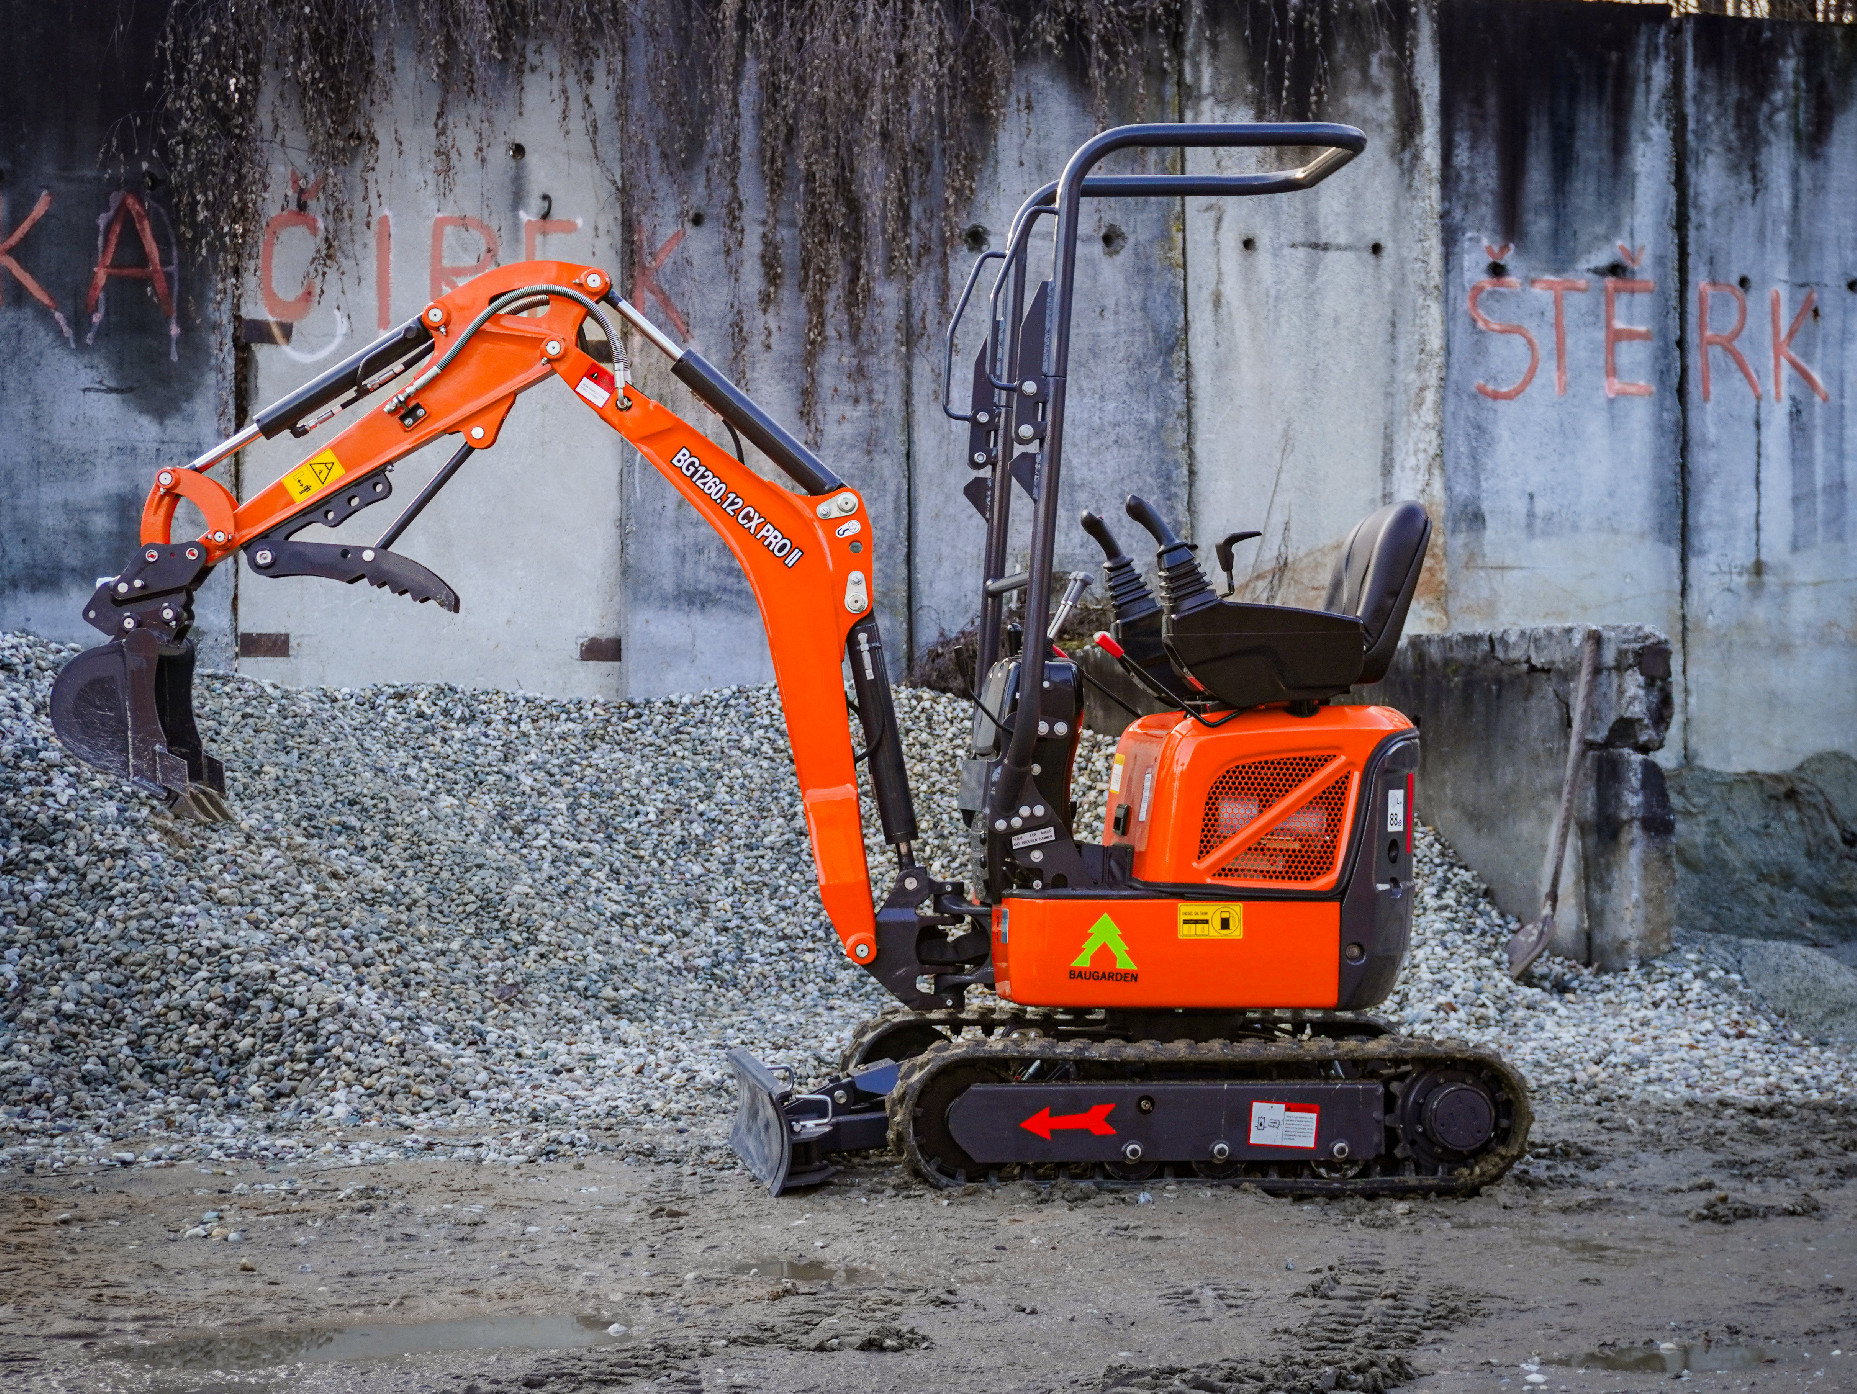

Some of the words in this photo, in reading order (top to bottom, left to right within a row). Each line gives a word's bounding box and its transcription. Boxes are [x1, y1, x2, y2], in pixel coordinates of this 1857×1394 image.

[1467, 243, 1829, 402] ŠTĚRK
[670, 446, 744, 517] BG1260.12
[736, 506, 765, 535] CX
[755, 521, 793, 558] PRO
[1069, 969, 1139, 983] BAUGARDEN
